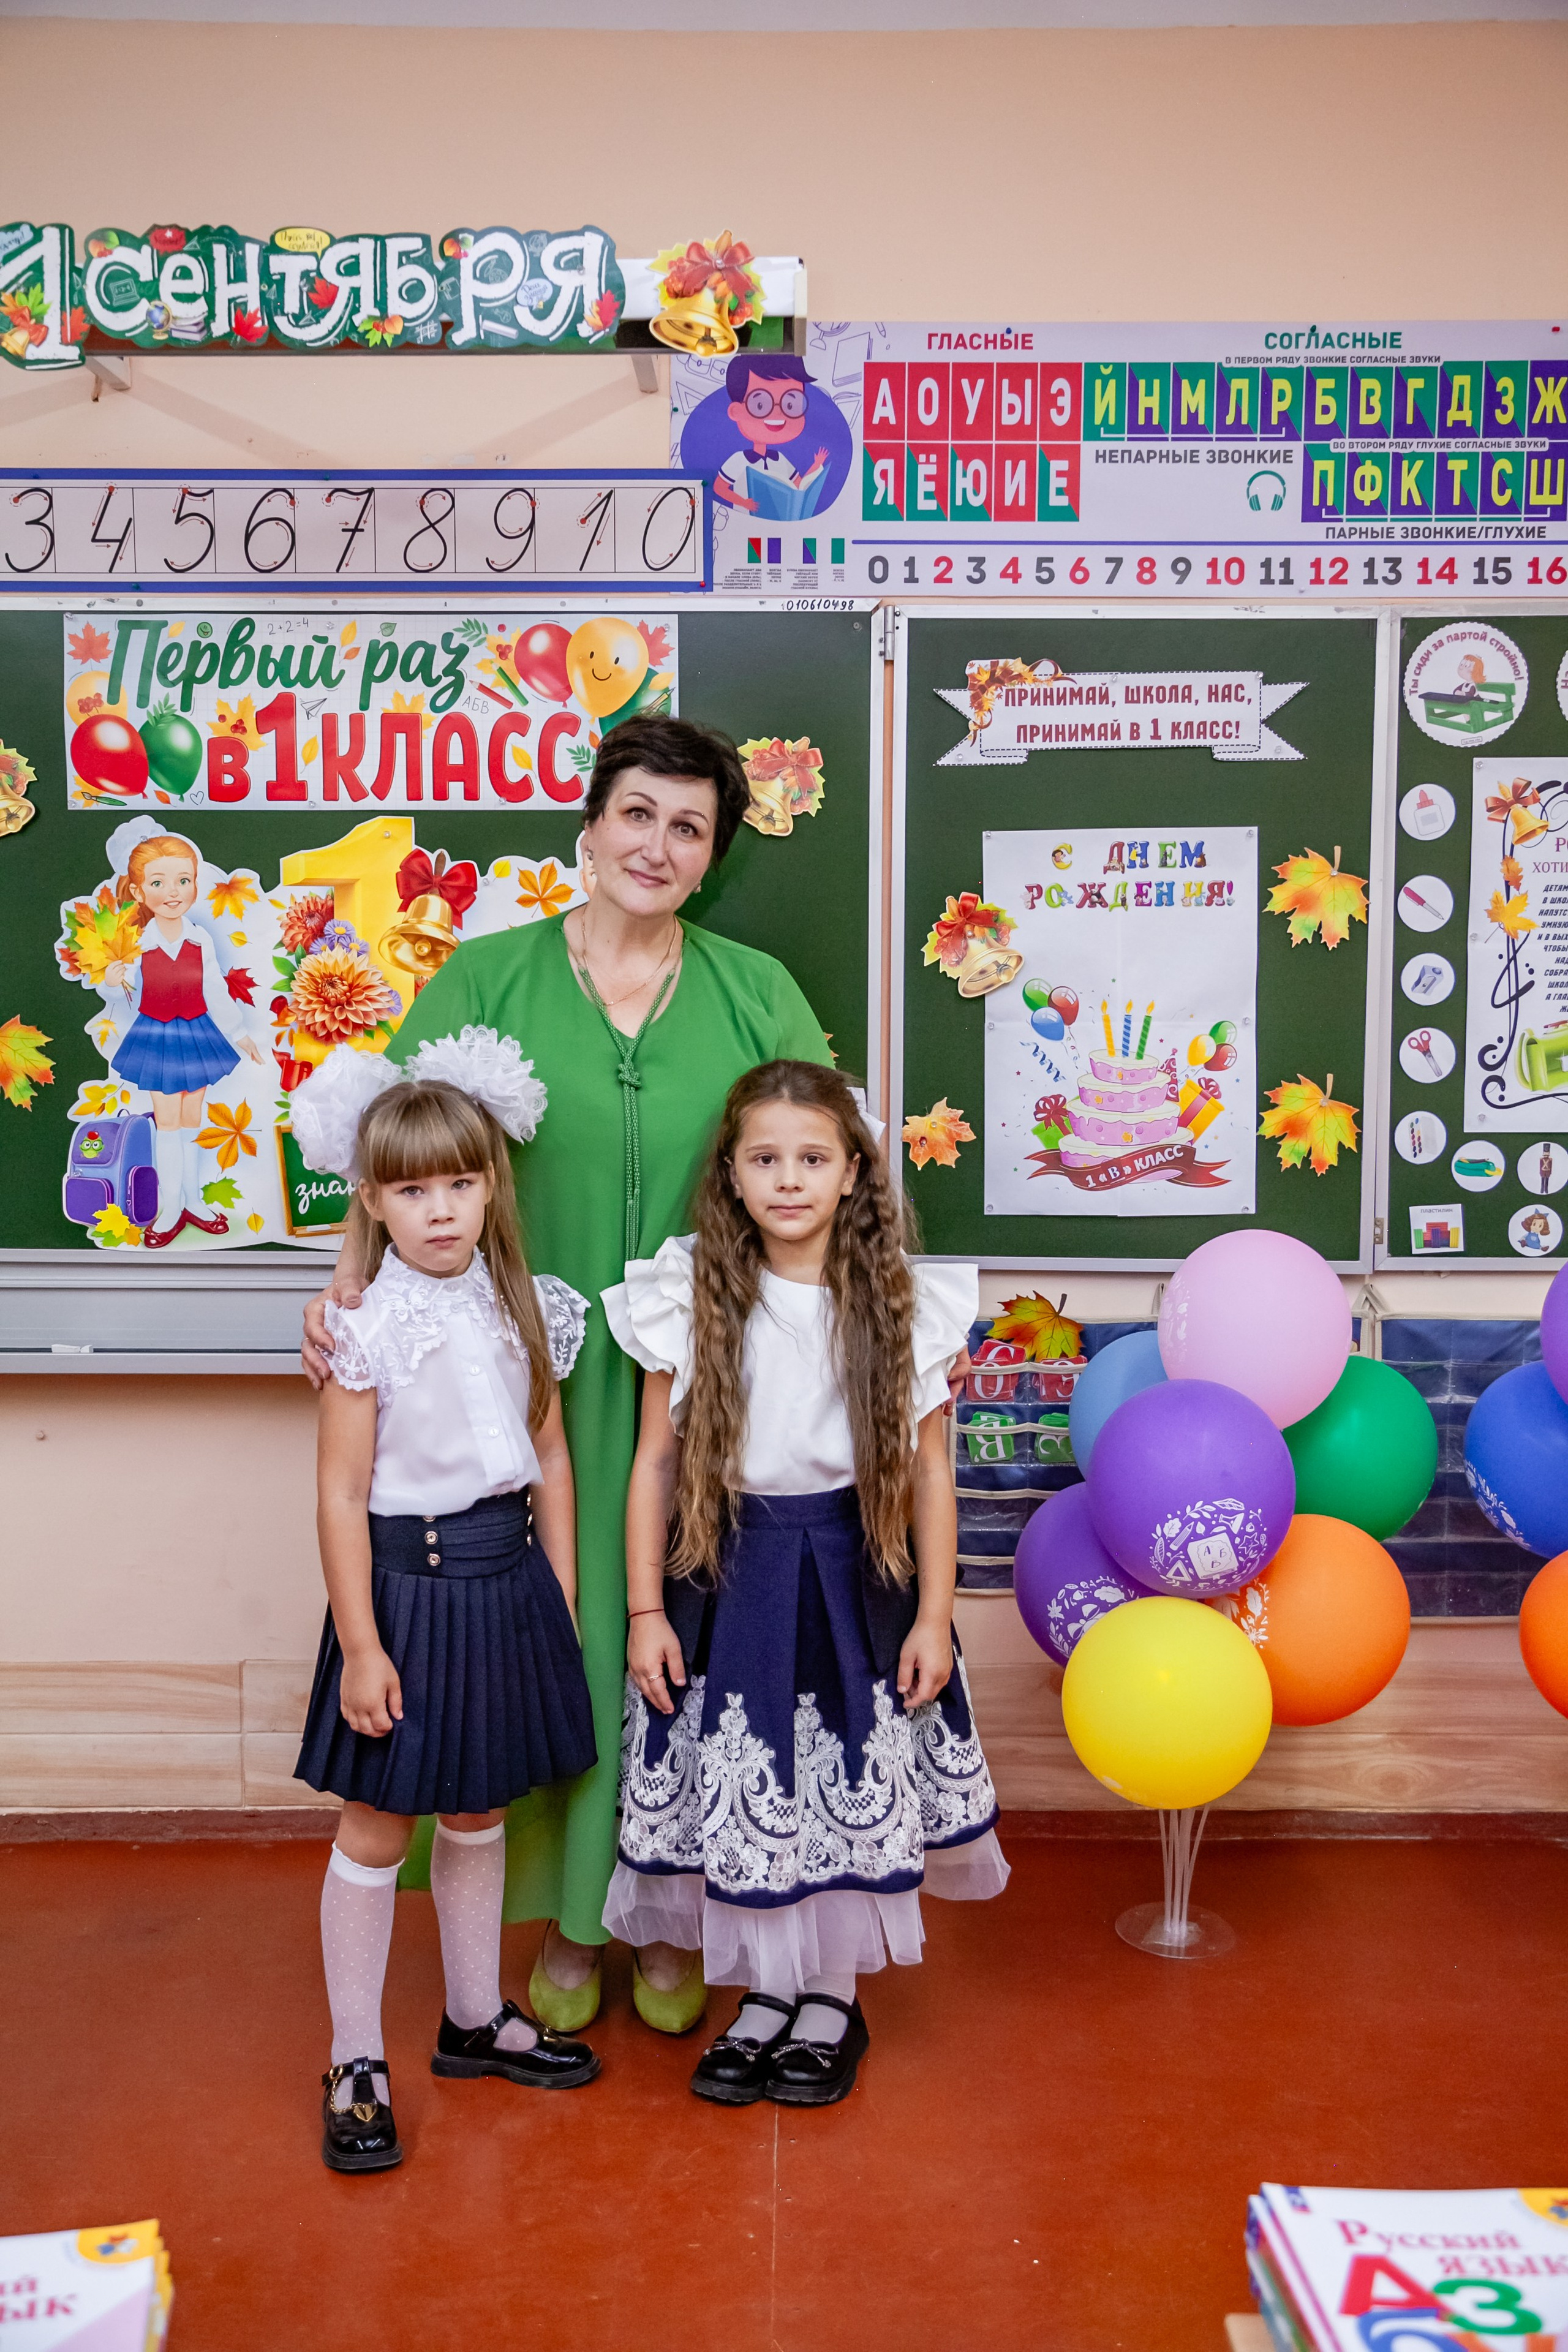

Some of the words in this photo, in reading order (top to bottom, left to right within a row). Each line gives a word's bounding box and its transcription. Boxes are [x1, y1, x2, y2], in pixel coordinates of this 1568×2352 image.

[927, 333, 1033, 350] ГЛАСНЫЕ
[1264, 331, 1402, 350] СОГЛАСНЫЕ
[1225, 355, 1231, 364] В
[1234, 355, 1272, 364] ПЕРВОМ
[1276, 355, 1300, 364] РЯДУ
[1303, 355, 1346, 364] ЗВОНКИЕ
[1349, 355, 1406, 364] СОГЛАСНЫЕ
[1409, 355, 1441, 364] ЗВУКИ
[872, 378, 896, 424] А
[919, 377, 940, 426] О
[960, 378, 984, 425] У
[1001, 379, 1031, 425] Ы
[1050, 377, 1071, 426] Э
[1094, 364, 1115, 424] Й
[1138, 379, 1160, 424] Н
[1181, 379, 1205, 424] М
[1226, 378, 1249, 424] Л
[1271, 378, 1292, 424] Р
[1315, 378, 1336, 424] Б
[1359, 378, 1381, 424] В
[1406, 378, 1425, 424] Г
[1447, 375, 1472, 427] Д
[1494, 377, 1515, 424] З
[1532, 377, 1567, 424] Ж
[1095, 450, 1200, 464] НЕПАРНЫЕ
[1206, 450, 1294, 464] ЗВОНКИЕ
[1333, 440, 1346, 450] ВО
[1348, 440, 1385, 450] ВТОРОМ
[1389, 440, 1414, 450] РЯДУ
[1416, 440, 1452, 450] ГЛУХИЕ
[1454, 440, 1512, 450] СОГЛАСНЫЕ
[1514, 440, 1546, 450] ЗВУКИ
[873, 459, 894, 505] Я
[918, 454, 937, 510] Ё
[956, 459, 987, 507] Ю
[1005, 460, 1026, 506] И
[1049, 460, 1069, 506] Е
[1313, 460, 1335, 506] П
[1354, 459, 1382, 506] Ф
[1401, 460, 1424, 506] К
[1447, 460, 1468, 506] Т
[1491, 459, 1513, 506] С
[1529, 459, 1564, 505] Ш
[5, 488, 54, 573] 3
[91, 488, 132, 573] 4
[164, 488, 214, 573] 5
[245, 488, 295, 573] 6
[328, 488, 374, 573] 7
[404, 488, 454, 573] 8
[486, 488, 535, 572] 9
[1325, 526, 1395, 540] ПАРНЫЕ
[1400, 526, 1547, 540] ЗВОНКИЕ/ГЛУХИЕ
[868, 556, 889, 585] 0
[903, 556, 919, 585] 1
[933, 556, 954, 585] 2
[967, 556, 986, 585] 3
[1000, 556, 1022, 585] 4
[1035, 556, 1055, 585] 5
[1069, 556, 1090, 585] 6
[1105, 556, 1123, 585] 7
[1136, 556, 1157, 585] 8
[1171, 556, 1192, 585] 9
[1206, 556, 1245, 585] 10
[1259, 556, 1294, 585] 11
[1310, 556, 1349, 585] 12
[1363, 556, 1402, 585] 13
[1417, 556, 1458, 585] 14
[1473, 556, 1512, 585] 15
[1527, 556, 1567, 585] 16
[107, 617, 345, 713] Первый
[360, 631, 470, 714] раз
[1409, 679, 1419, 696] Ты
[1414, 649, 1433, 676] сиди
[1432, 639, 1444, 651] за
[1447, 631, 1488, 643] партой
[1489, 638, 1525, 680] стройно!
[462, 696, 489, 714] АБВ
[1005, 683, 1116, 707] ПРИНИМАЙ,
[1125, 684, 1199, 706] ШКОЛА,
[1208, 683, 1251, 705] НАС,
[1017, 719, 1121, 743] ПРИНИМАЙ
[1129, 722, 1140, 741] В
[1150, 718, 1161, 741] 1
[1170, 720, 1240, 741] КЛАСС!
[255, 692, 308, 802] 1
[322, 712, 584, 803] КЛАСС
[1052, 842, 1072, 870] С
[1104, 840, 1207, 875] ДНЕМ
[1555, 837, 1568, 852] Р
[1022, 880, 1234, 911] РОЖДЕНИЯ!
[1133, 1145, 1184, 1172] КЛАСС
[1337, 2219, 1521, 2254] Русский
